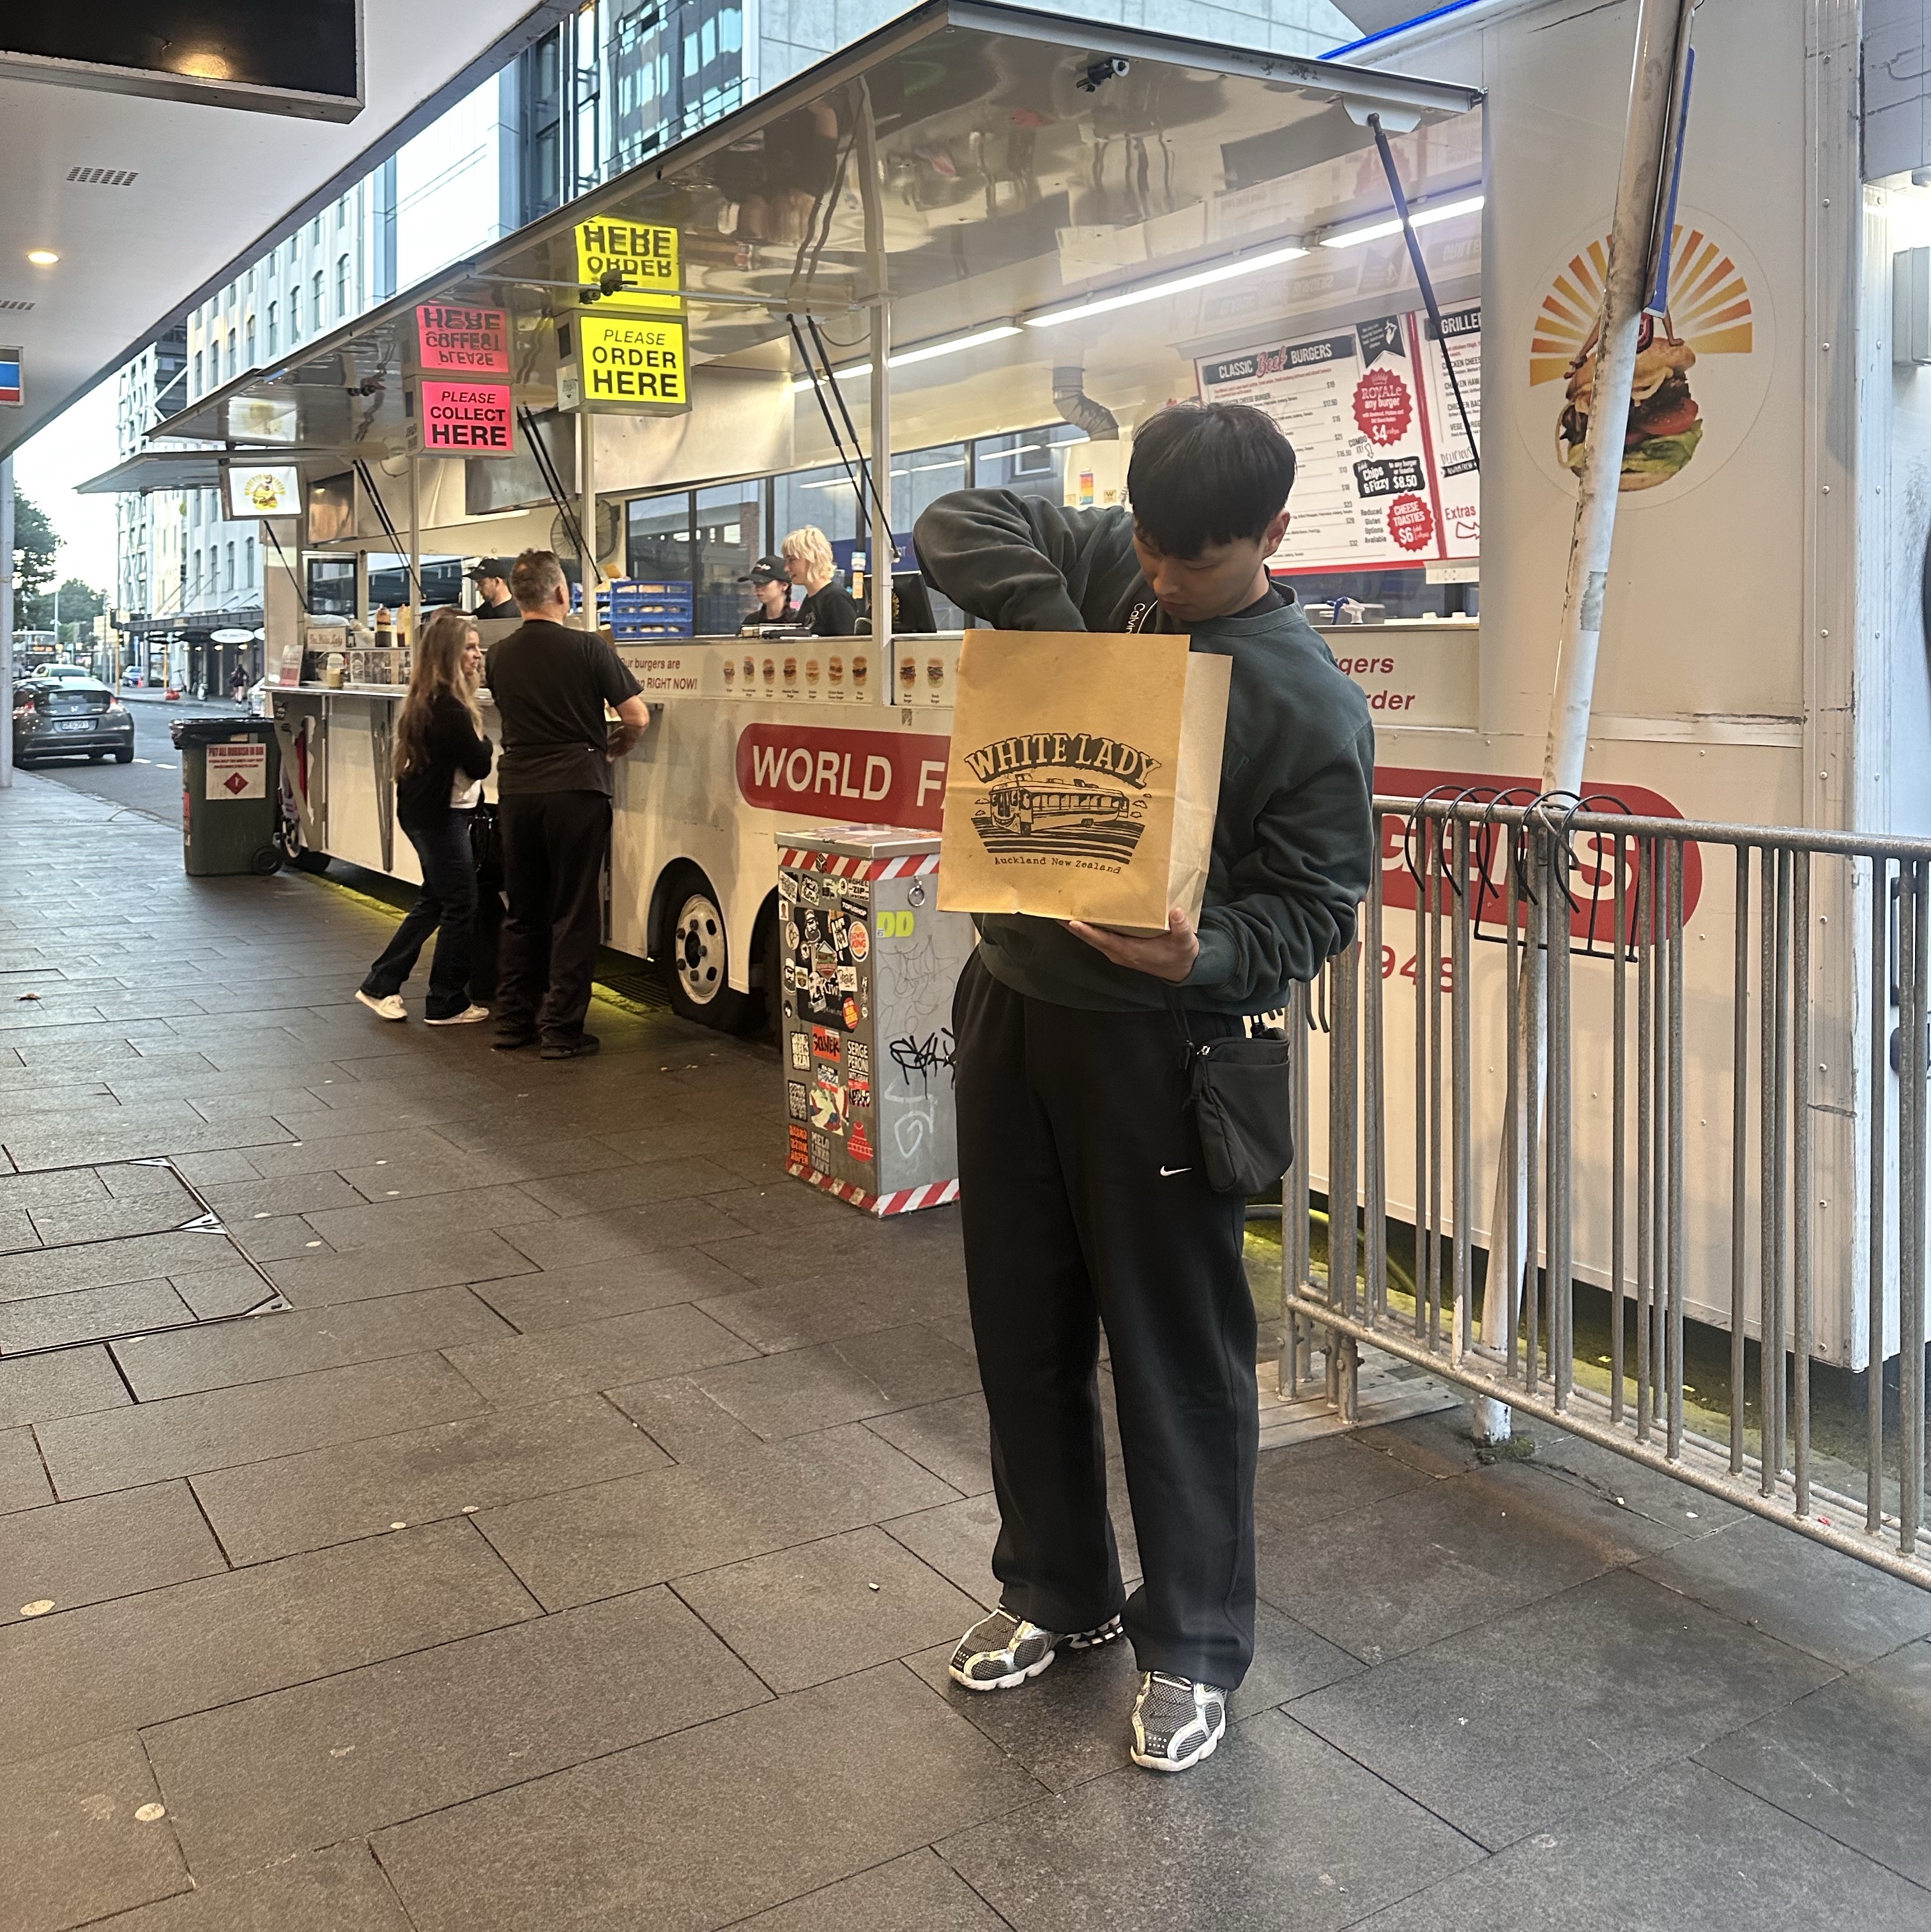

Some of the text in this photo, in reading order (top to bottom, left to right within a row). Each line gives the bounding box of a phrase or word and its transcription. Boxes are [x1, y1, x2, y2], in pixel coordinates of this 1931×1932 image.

[603, 328, 666, 346] PLEASE
[592, 346, 677, 369] ORDER
[1218, 342, 1332, 379] CLASSIC Beef BURGERS
[593, 369, 679, 398] HERE
[441, 390, 496, 404] PLEASE
[1364, 397, 1400, 411] any burger
[430, 406, 507, 422] COLLECT
[432, 424, 507, 447] HERE
[1372, 424, 1387, 441] $4
[1362, 466, 1385, 482] Chips
[1393, 474, 1418, 489] $8.50
[1393, 500, 1420, 516] CHEESE
[1444, 505, 1477, 521] Extras
[1393, 510, 1426, 528] TOASTIES
[1398, 526, 1414, 545] $6
[634, 657, 666, 671] burgers
[667, 659, 681, 670] are
[646, 677, 672, 689] RIGHT
[673, 678, 698, 690] NOW!
[964, 732, 1162, 790] WHITE LADY
[752, 745, 892, 801] WORLD
[994, 856, 1122, 875] Auckland New Zealand
[848, 1040, 868, 1059] SERGE
